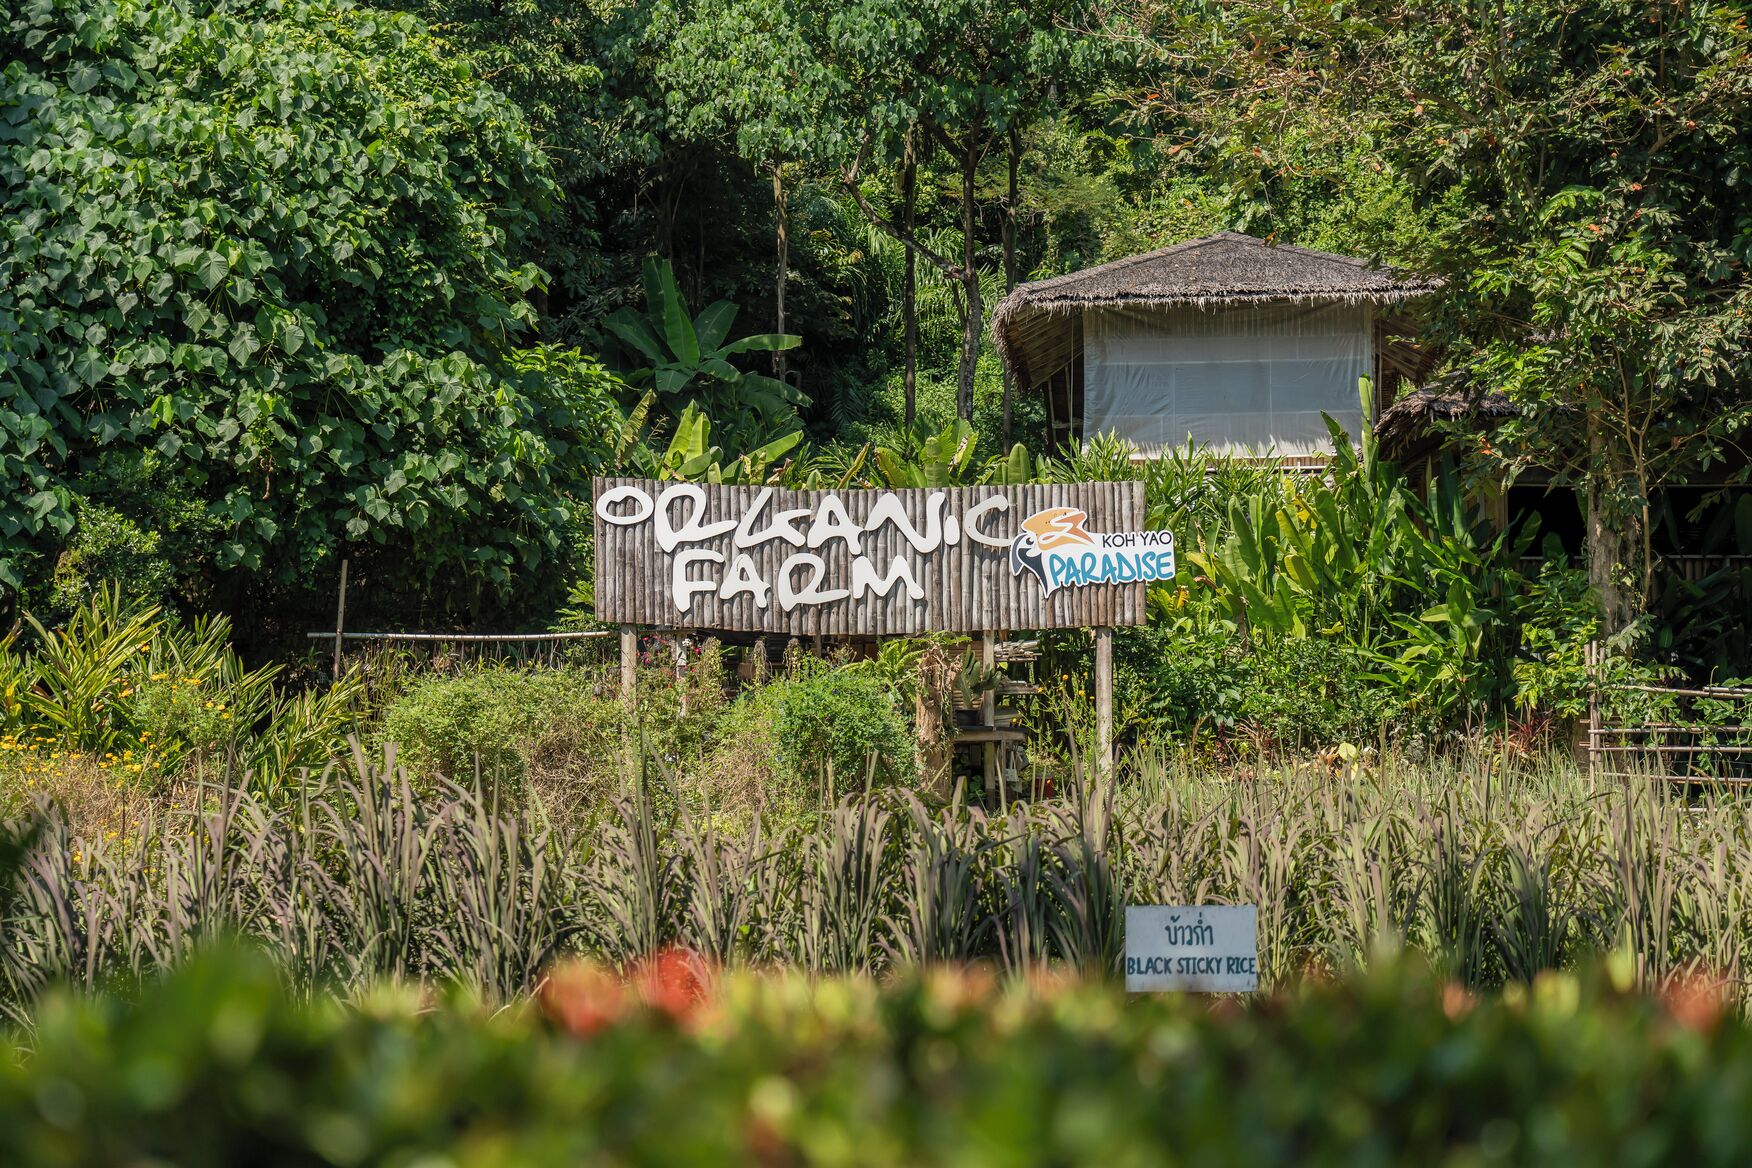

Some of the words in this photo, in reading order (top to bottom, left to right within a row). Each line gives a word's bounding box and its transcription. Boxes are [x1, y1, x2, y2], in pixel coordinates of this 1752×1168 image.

[1102, 534, 1136, 549] KOH
[1139, 531, 1173, 546] YAO
[672, 548, 925, 613] FARM
[1048, 551, 1174, 587] PARADISE
[1127, 956, 1173, 975] BLACK
[1176, 956, 1222, 975] STICKY
[1226, 956, 1256, 975] RICE
